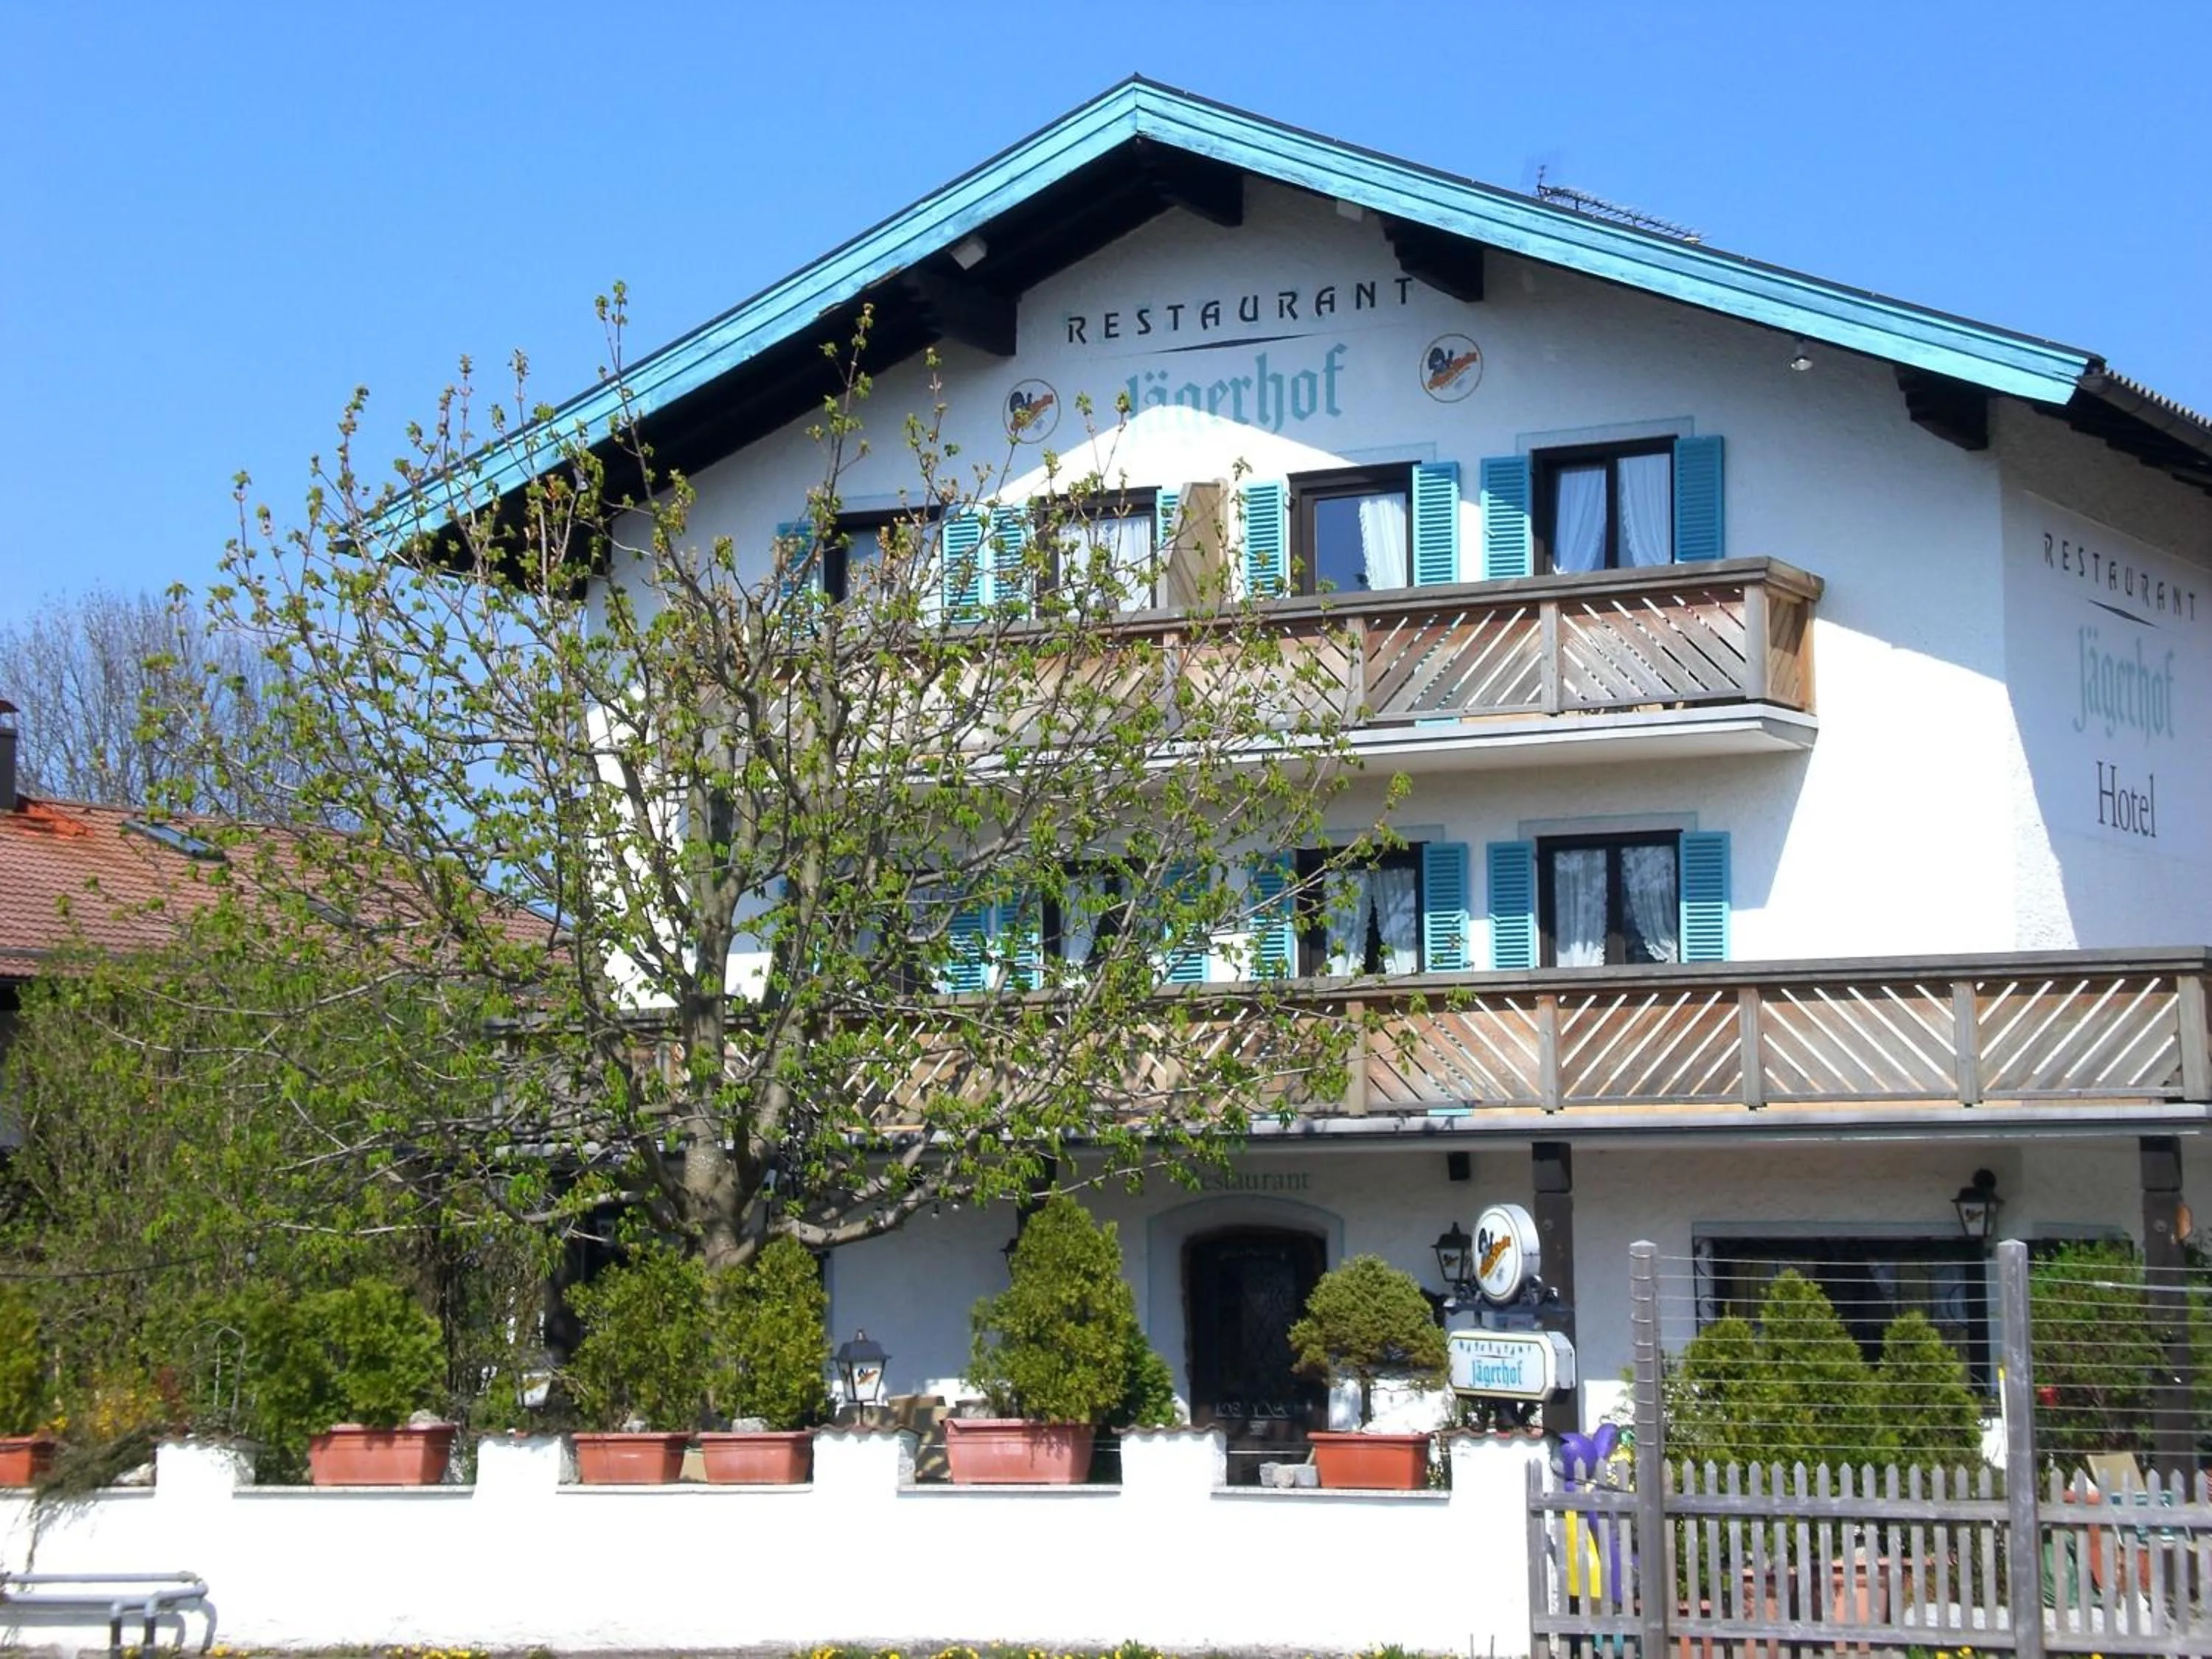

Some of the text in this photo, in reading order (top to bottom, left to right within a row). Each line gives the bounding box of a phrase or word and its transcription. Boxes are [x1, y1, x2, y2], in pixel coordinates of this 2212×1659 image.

[1068, 277, 1413, 344] RESTAURANT
[2044, 532, 2196, 620] RESTAURANT
[2073, 625, 2176, 746] Jägerhof
[2096, 760, 2157, 838] Hotel
[1468, 1359, 1523, 1388] Jägerhof
